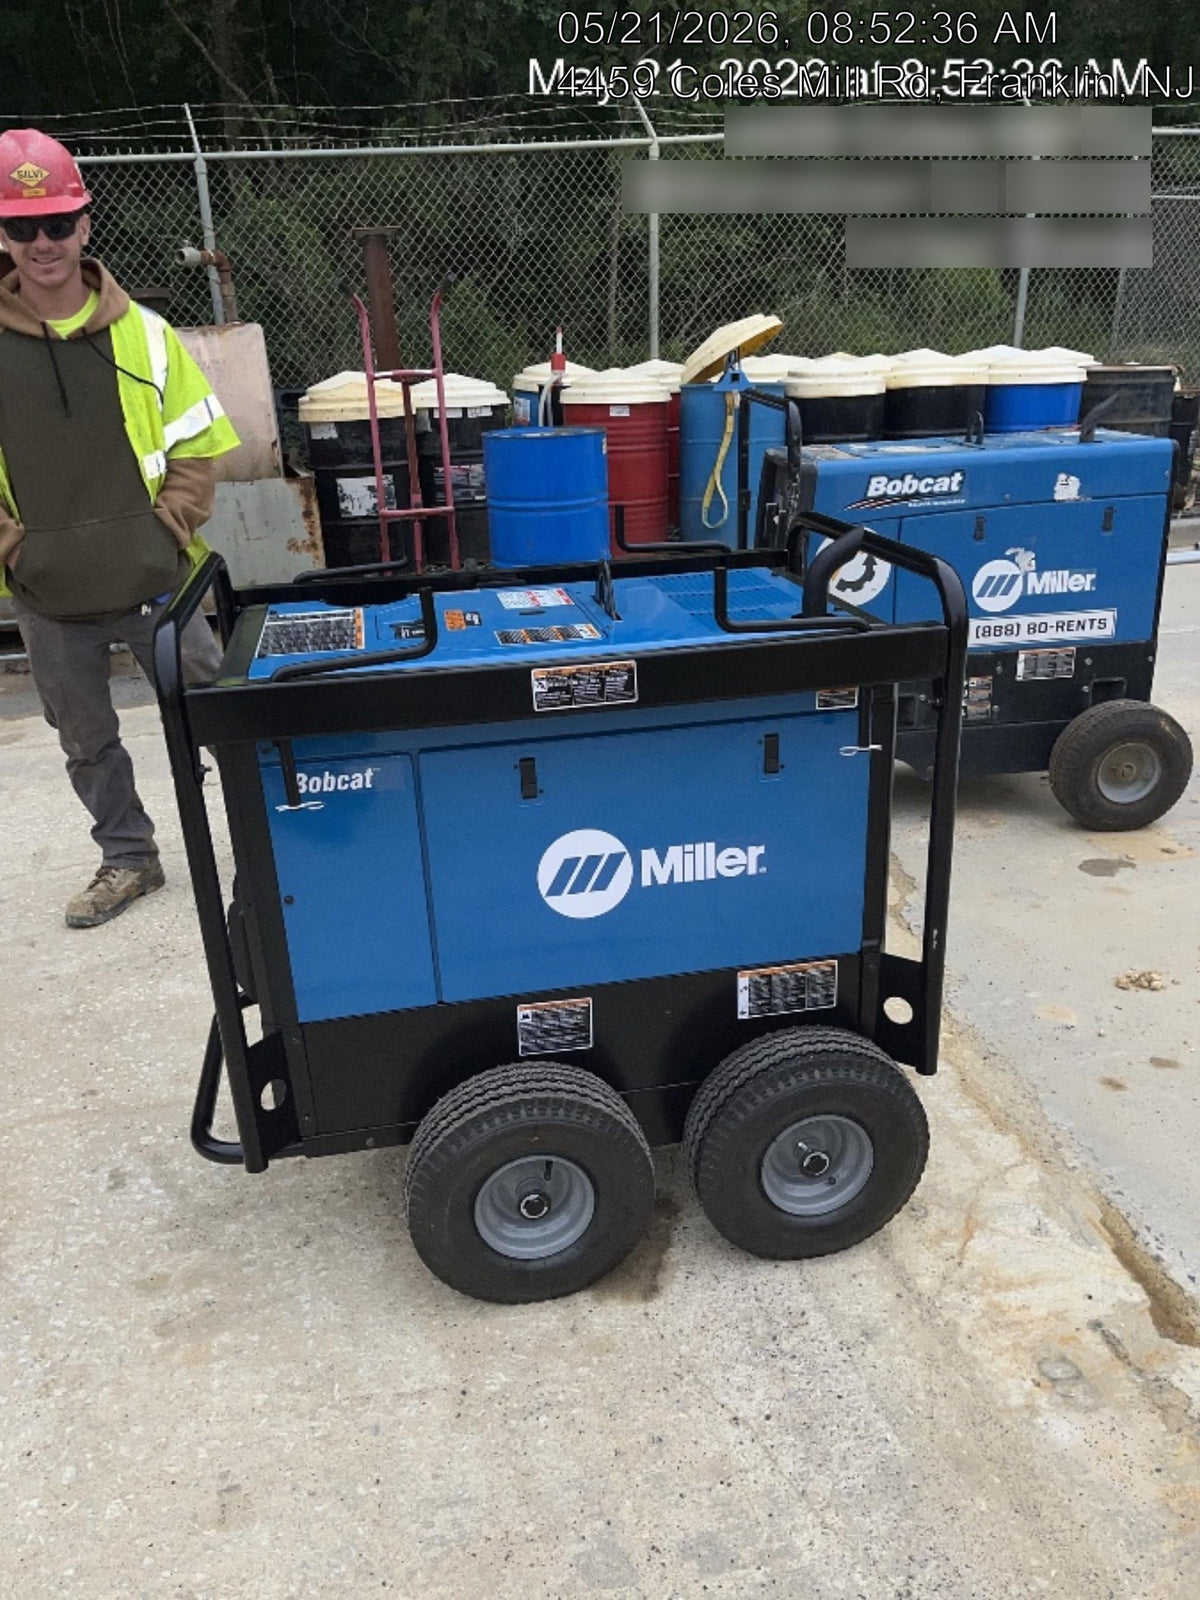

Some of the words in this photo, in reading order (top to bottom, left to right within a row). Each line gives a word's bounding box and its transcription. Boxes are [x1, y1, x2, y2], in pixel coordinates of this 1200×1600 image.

[17, 170, 44, 180] SILVI
[867, 471, 964, 498] Bobcat
[1027, 569, 1096, 595] Miller
[640, 842, 766, 887] Miller
